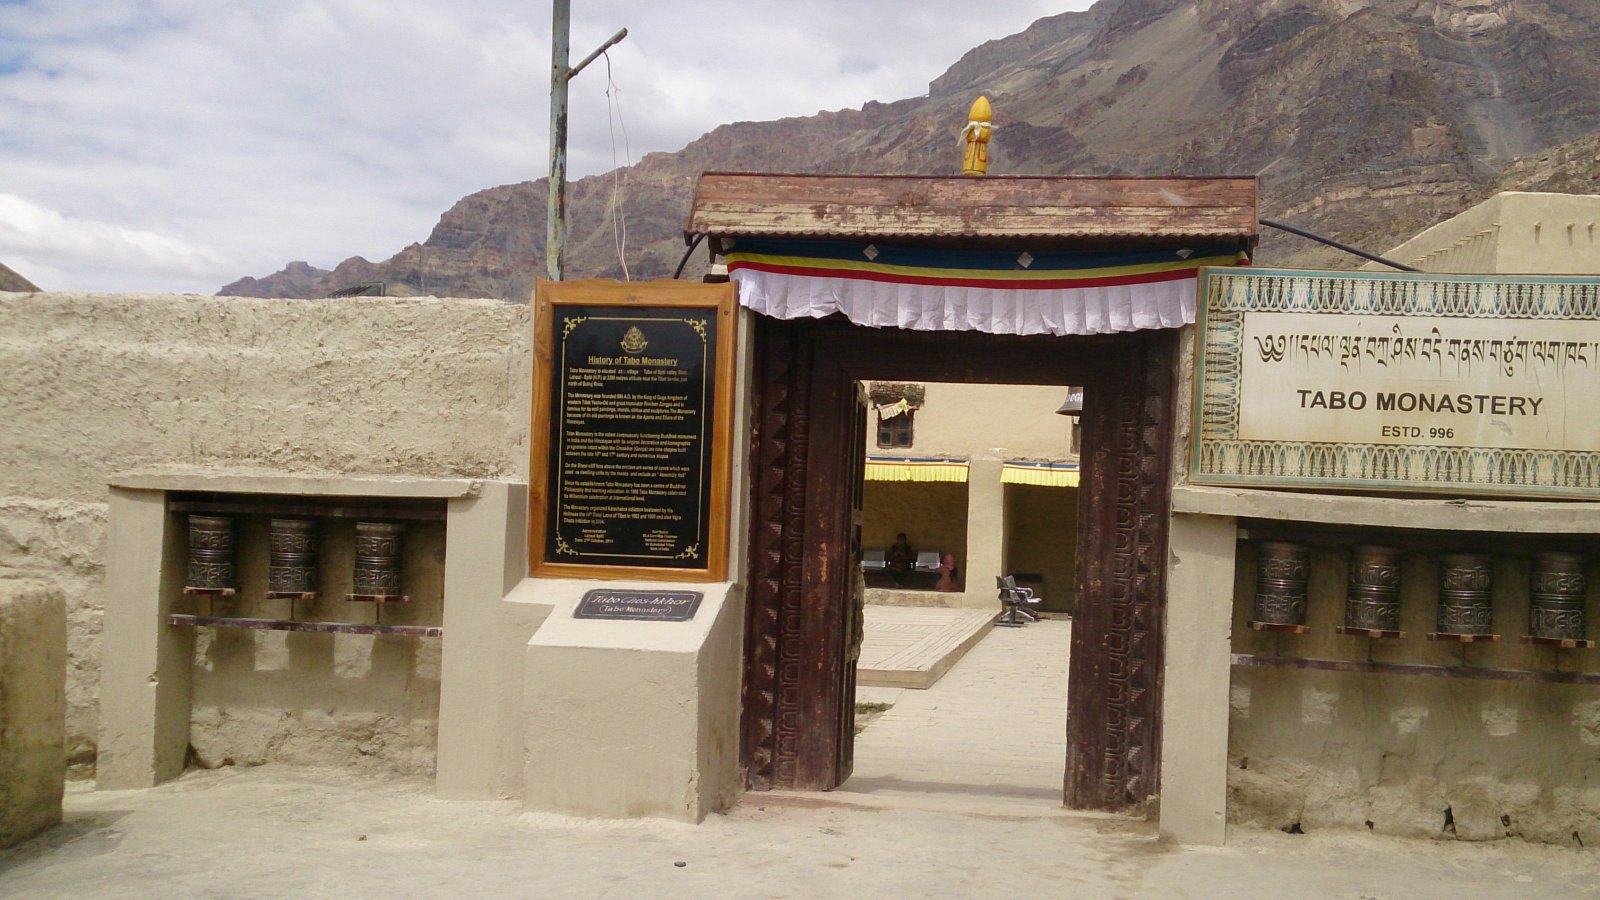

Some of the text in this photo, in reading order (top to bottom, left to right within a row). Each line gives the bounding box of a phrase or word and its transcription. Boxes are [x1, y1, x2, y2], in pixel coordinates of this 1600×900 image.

[588, 356, 678, 366] History of Tabo Monastery
[1297, 389, 1543, 416] TABO MONASTERY
[1382, 425, 1454, 439] ESTD. 996
[592, 596, 620, 604] Tabo
